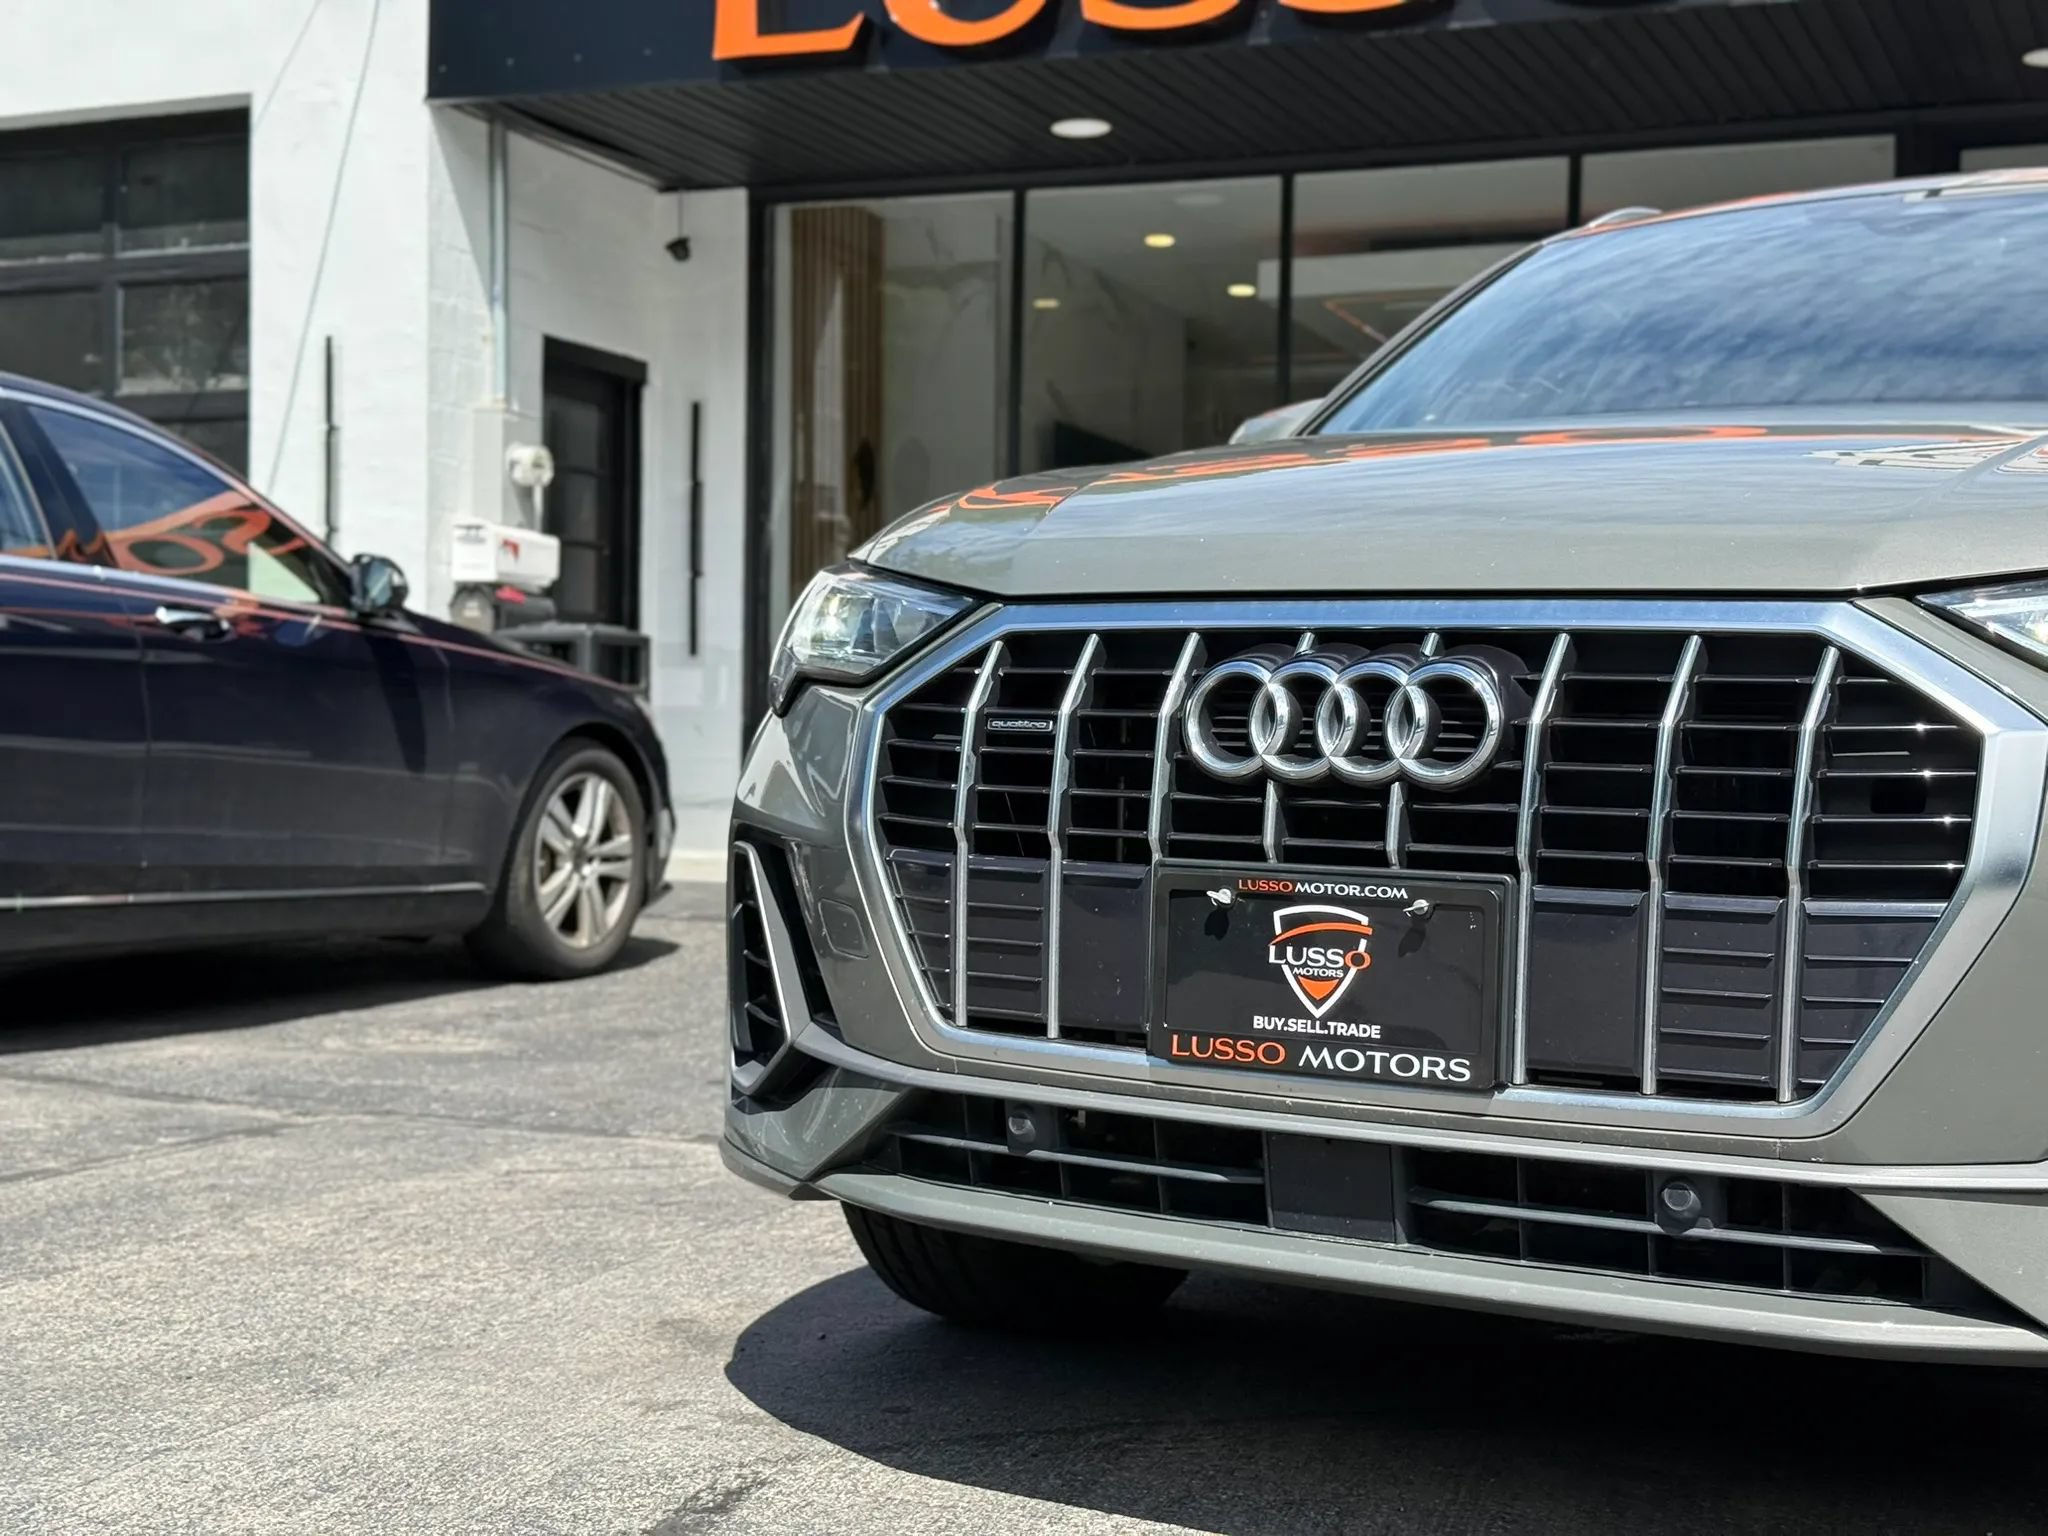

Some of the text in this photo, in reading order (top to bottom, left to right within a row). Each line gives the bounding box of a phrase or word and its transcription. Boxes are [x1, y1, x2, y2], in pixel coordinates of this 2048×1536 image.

[991, 720, 1047, 729] quattro
[1268, 944, 1372, 970] LUSSO
[1292, 967, 1344, 978] MOTORS
[1253, 1015, 1381, 1039] BUY.SELL.TRADE
[1171, 1033, 1472, 1082] LUSSO MOTORS
